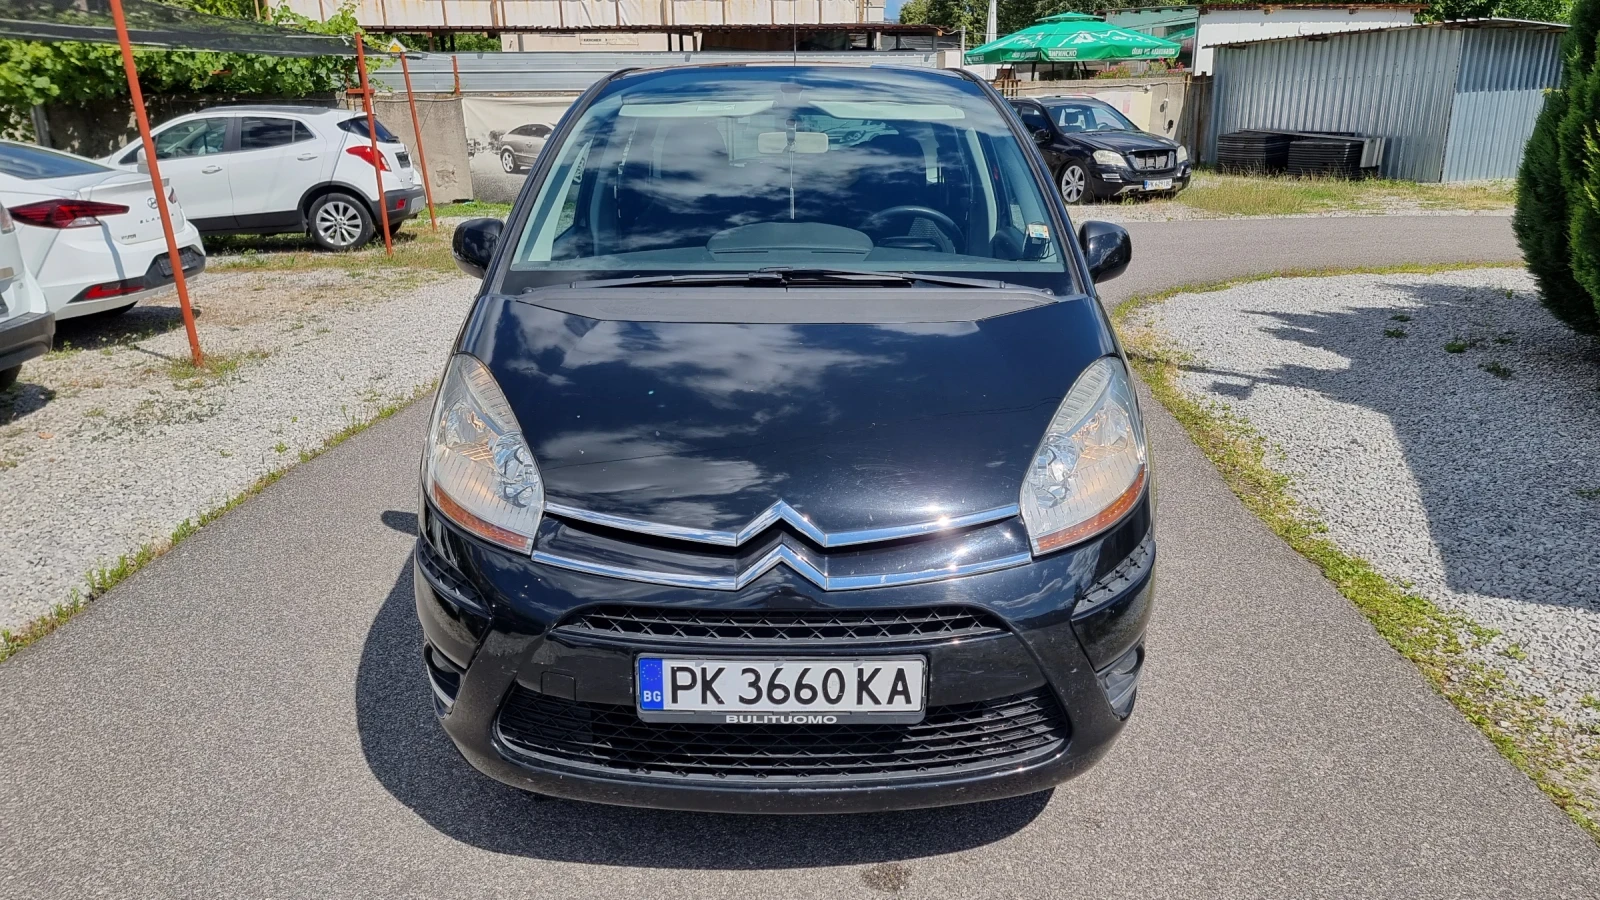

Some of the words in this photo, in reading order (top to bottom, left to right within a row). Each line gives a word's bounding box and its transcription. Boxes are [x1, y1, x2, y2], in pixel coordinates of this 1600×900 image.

[670, 666, 726, 705] PK
[738, 667, 846, 705] 3660
[856, 667, 913, 706] KA
[643, 690, 661, 702] BG
[725, 714, 838, 725] BULITUOMO
